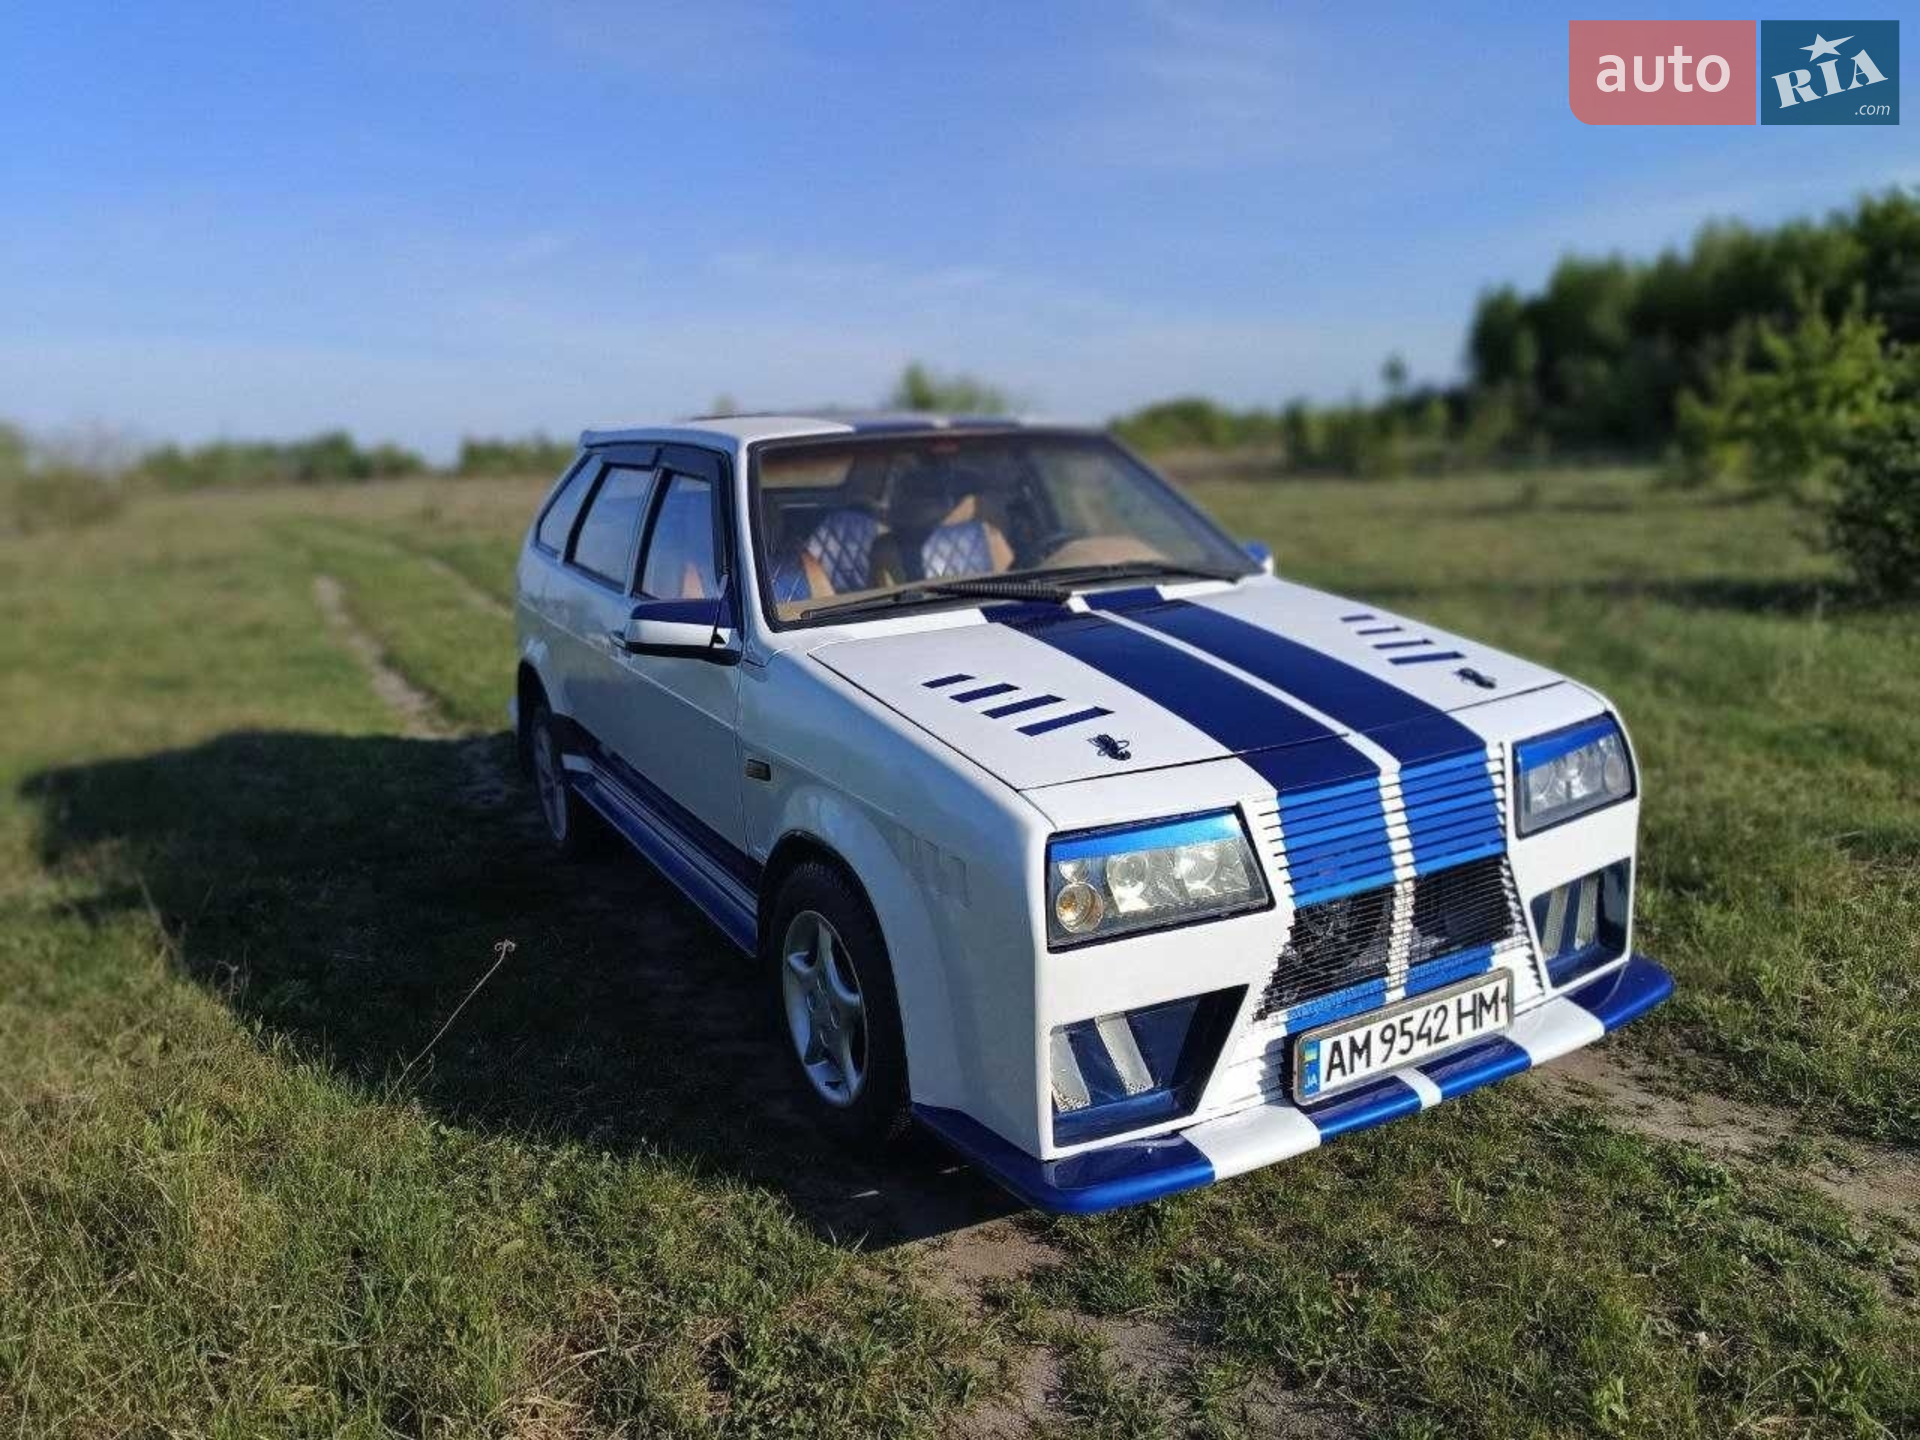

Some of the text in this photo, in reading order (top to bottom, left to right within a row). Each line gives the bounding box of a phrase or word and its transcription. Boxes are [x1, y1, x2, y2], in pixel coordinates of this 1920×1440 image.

[1325, 986, 1500, 1082] AM 9542 HM
